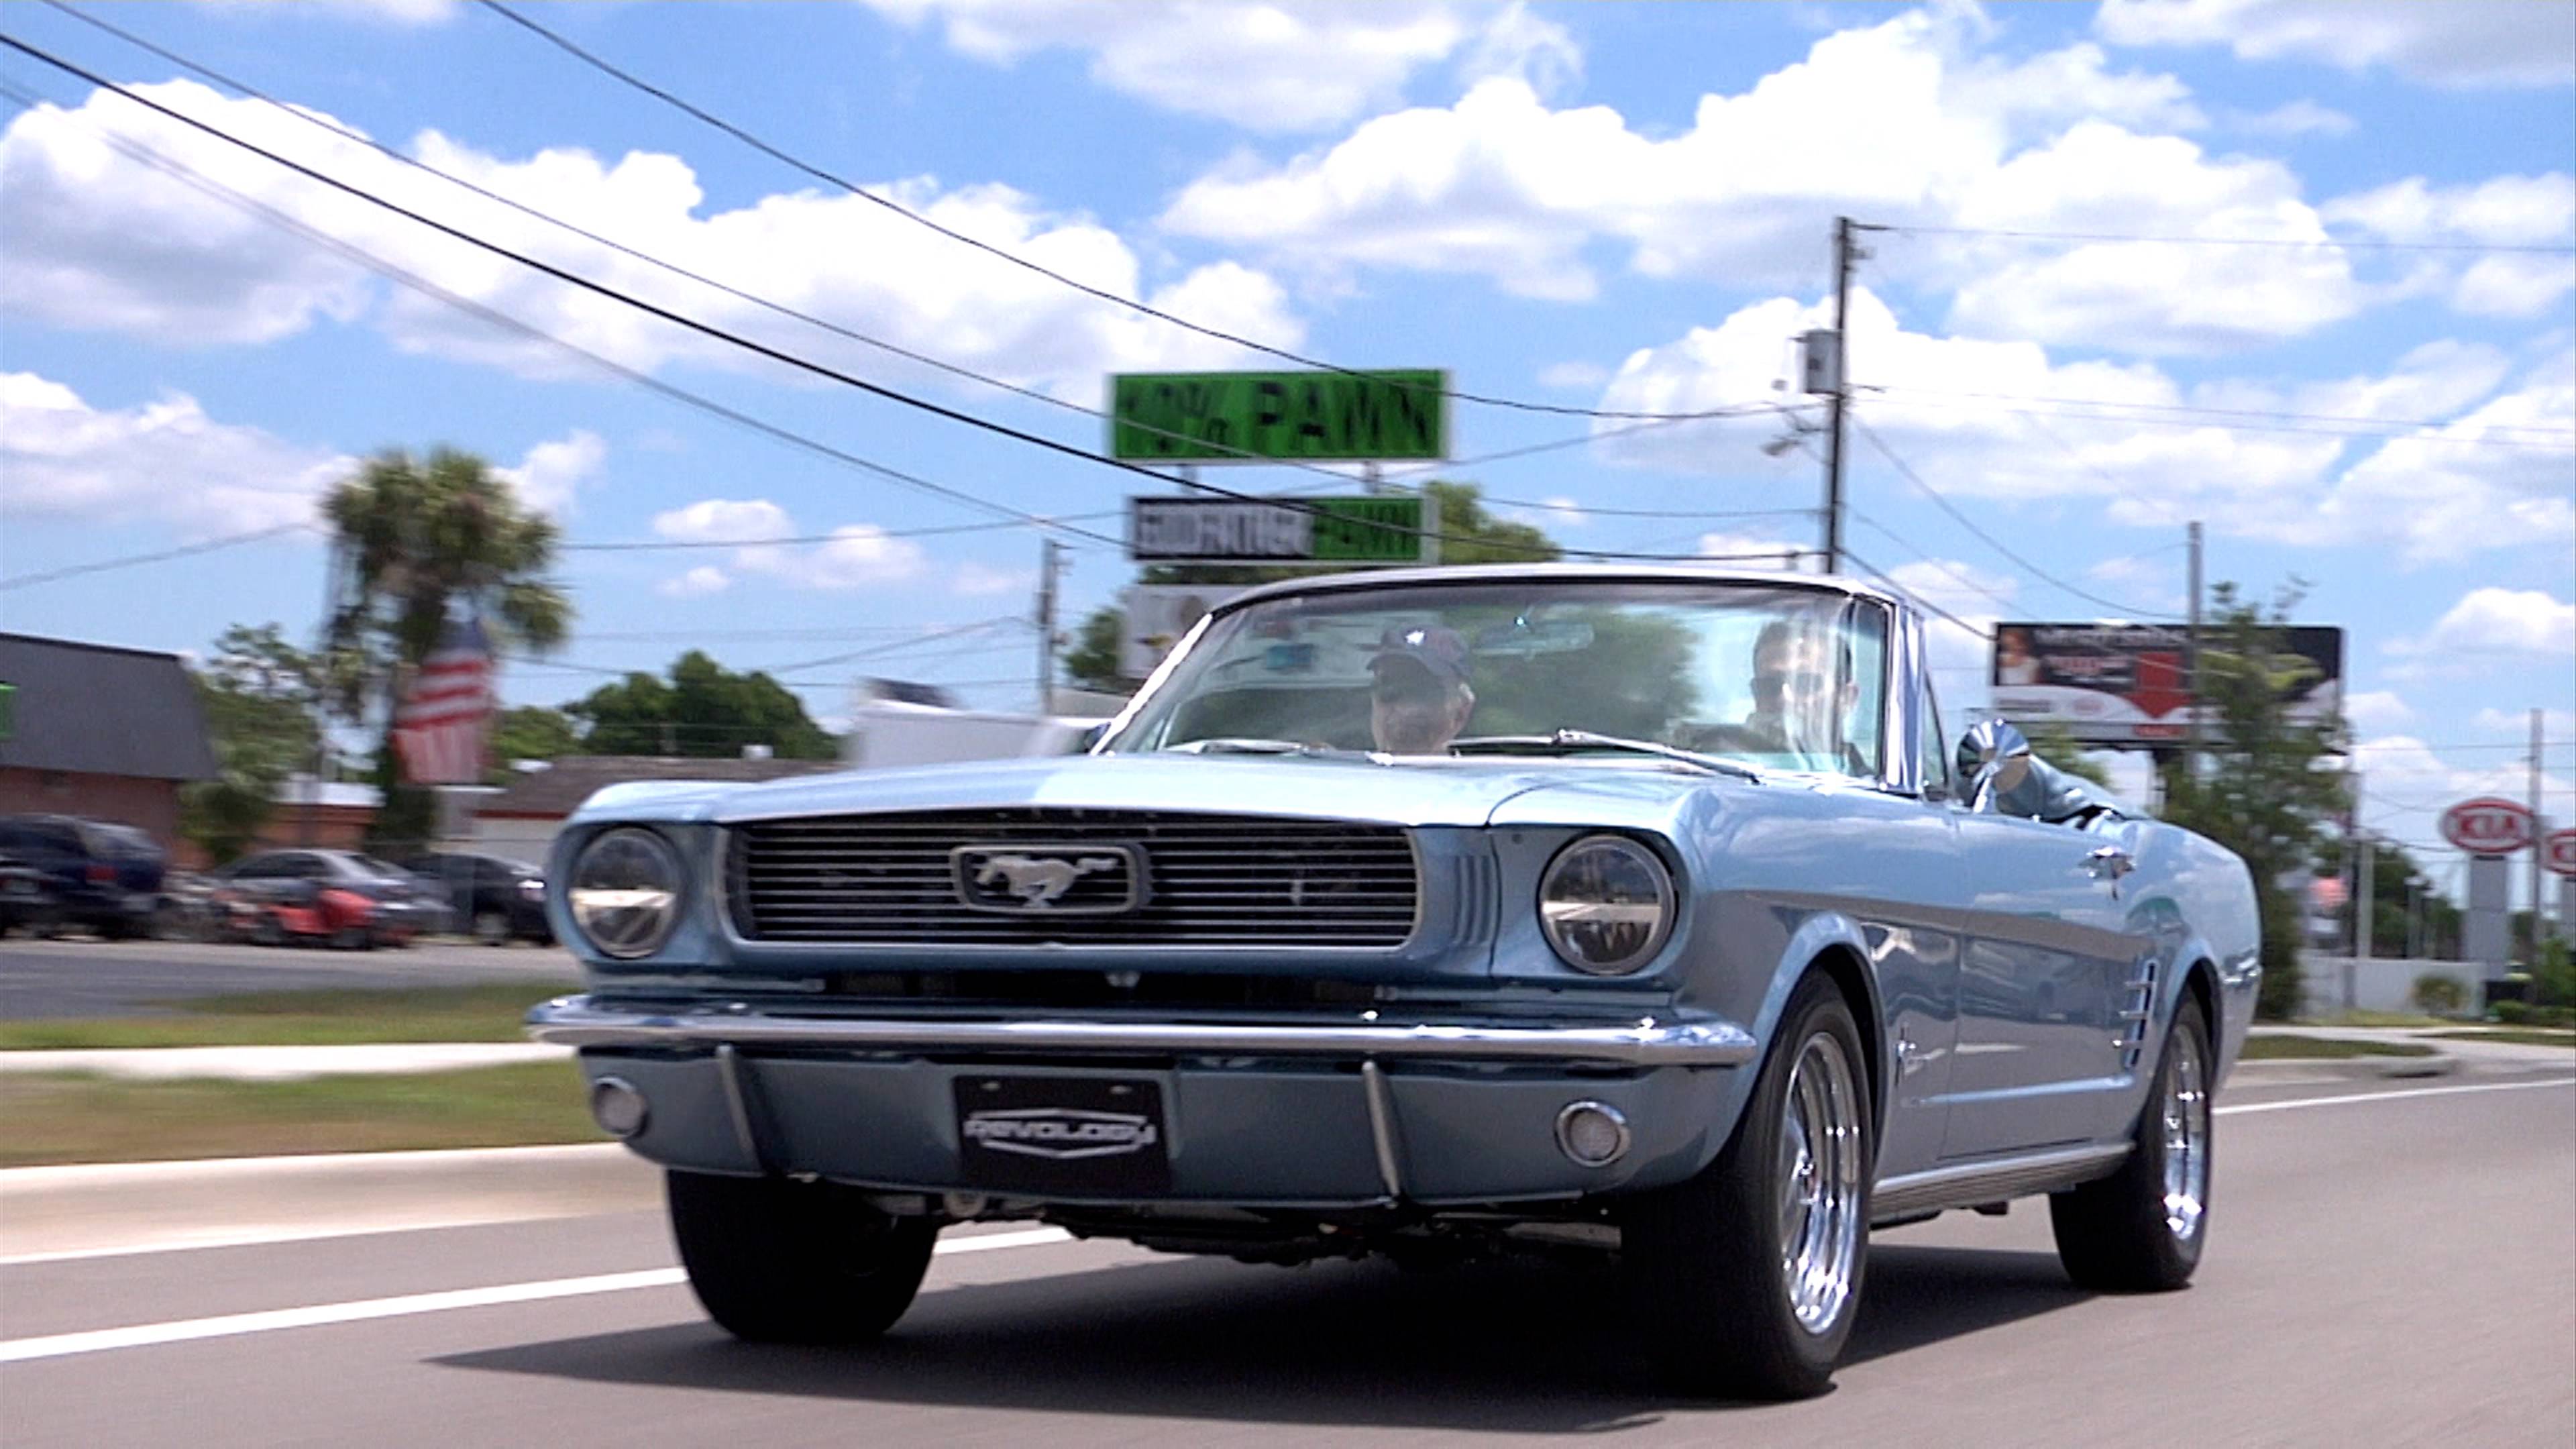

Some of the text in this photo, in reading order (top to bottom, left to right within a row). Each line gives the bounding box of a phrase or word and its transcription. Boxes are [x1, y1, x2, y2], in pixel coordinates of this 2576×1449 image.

[1253, 380, 1433, 453] PAWN
[2459, 815, 2520, 840] KIA
[963, 1120, 1157, 1144] REVOLOGY
